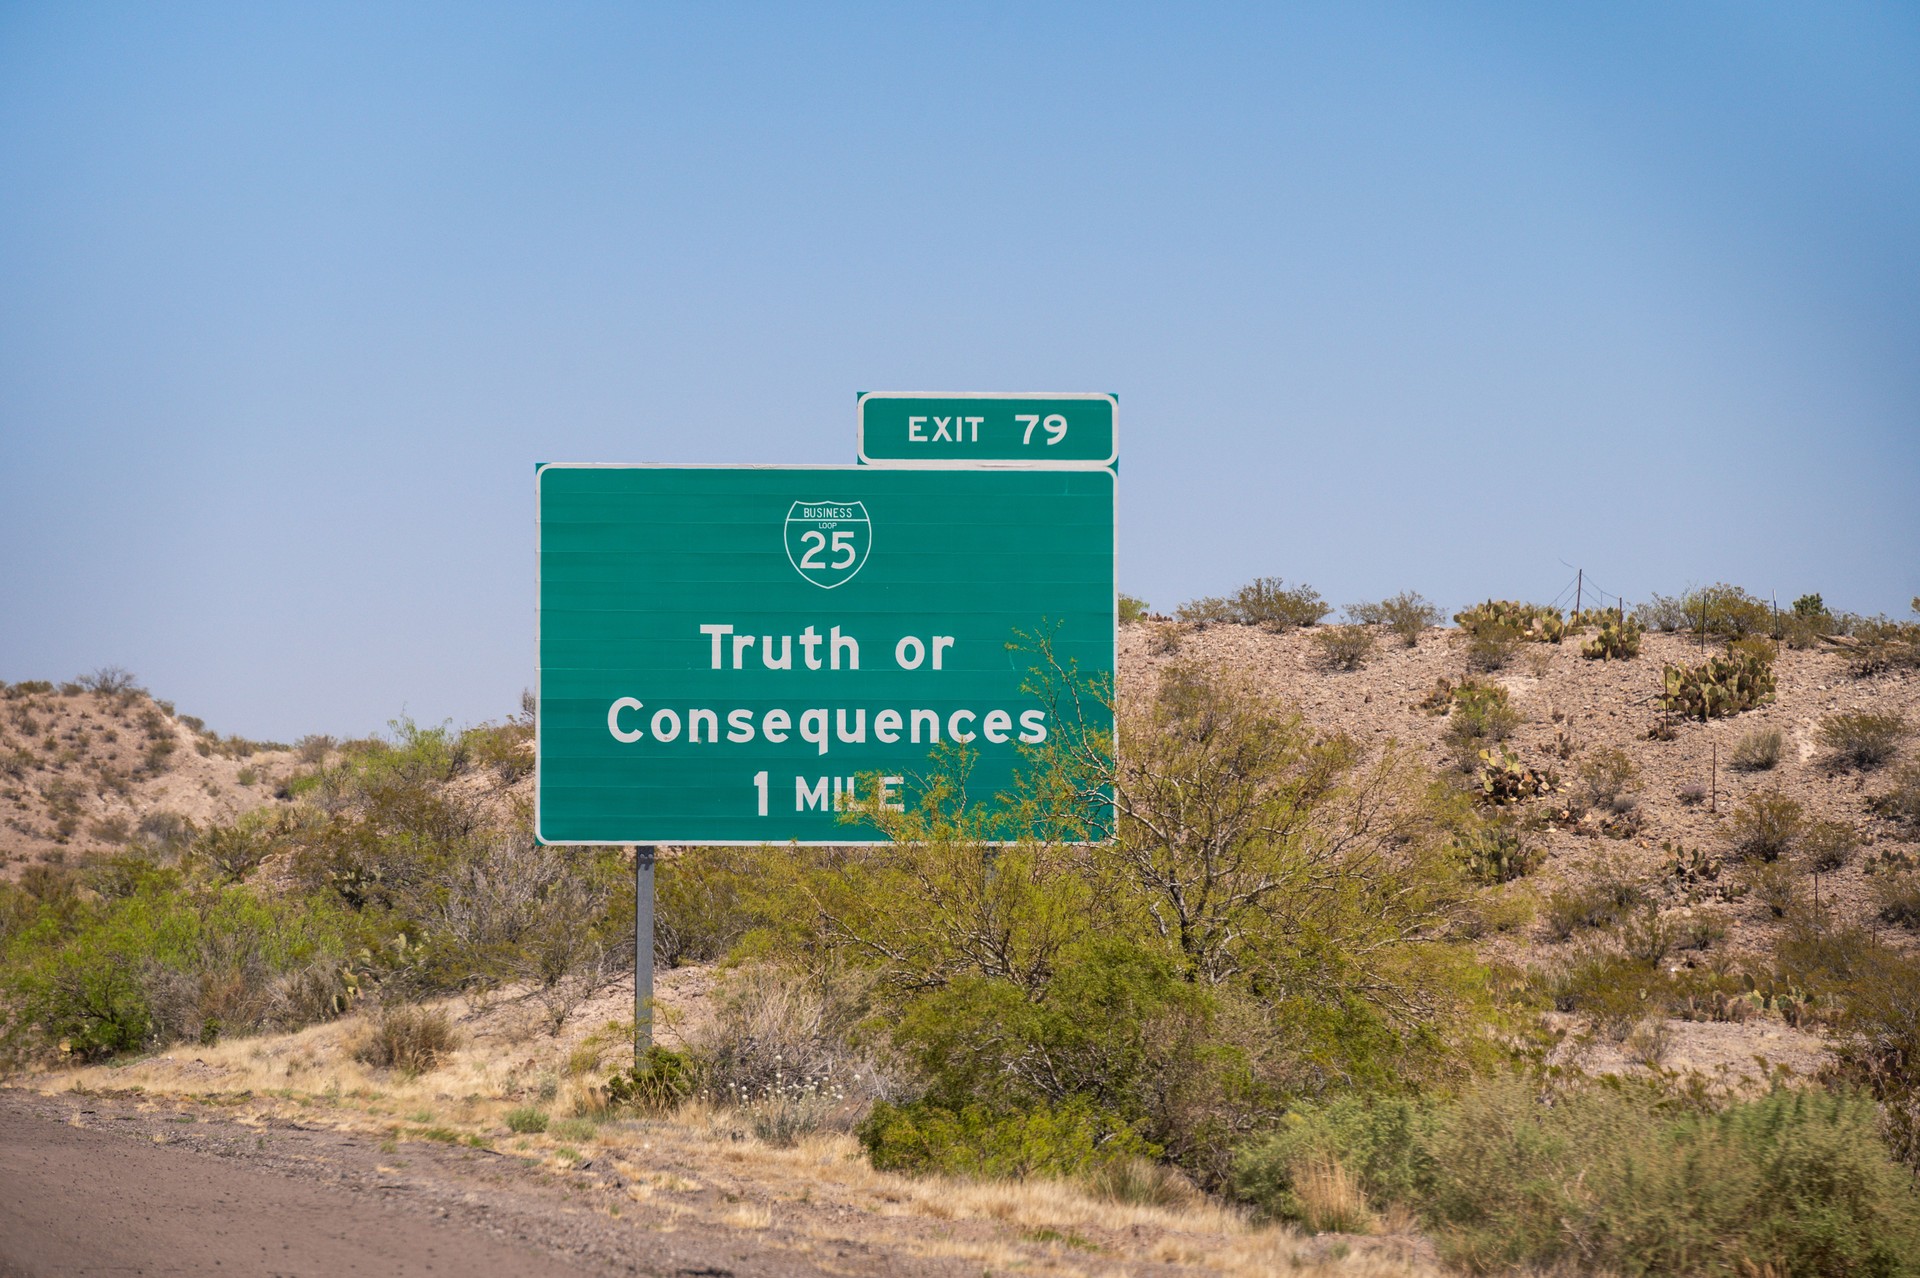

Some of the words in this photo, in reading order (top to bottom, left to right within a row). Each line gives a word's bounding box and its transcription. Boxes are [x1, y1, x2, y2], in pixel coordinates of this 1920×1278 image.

[909, 416, 984, 443] EXIT
[1014, 414, 1068, 445] 79
[804, 508, 852, 518] BUSINESS
[800, 530, 856, 570] 25
[700, 624, 860, 671] Truth
[895, 634, 955, 671] or
[607, 697, 1048, 756] Consequences
[753, 771, 769, 817] 1
[795, 776, 905, 813] MILE
